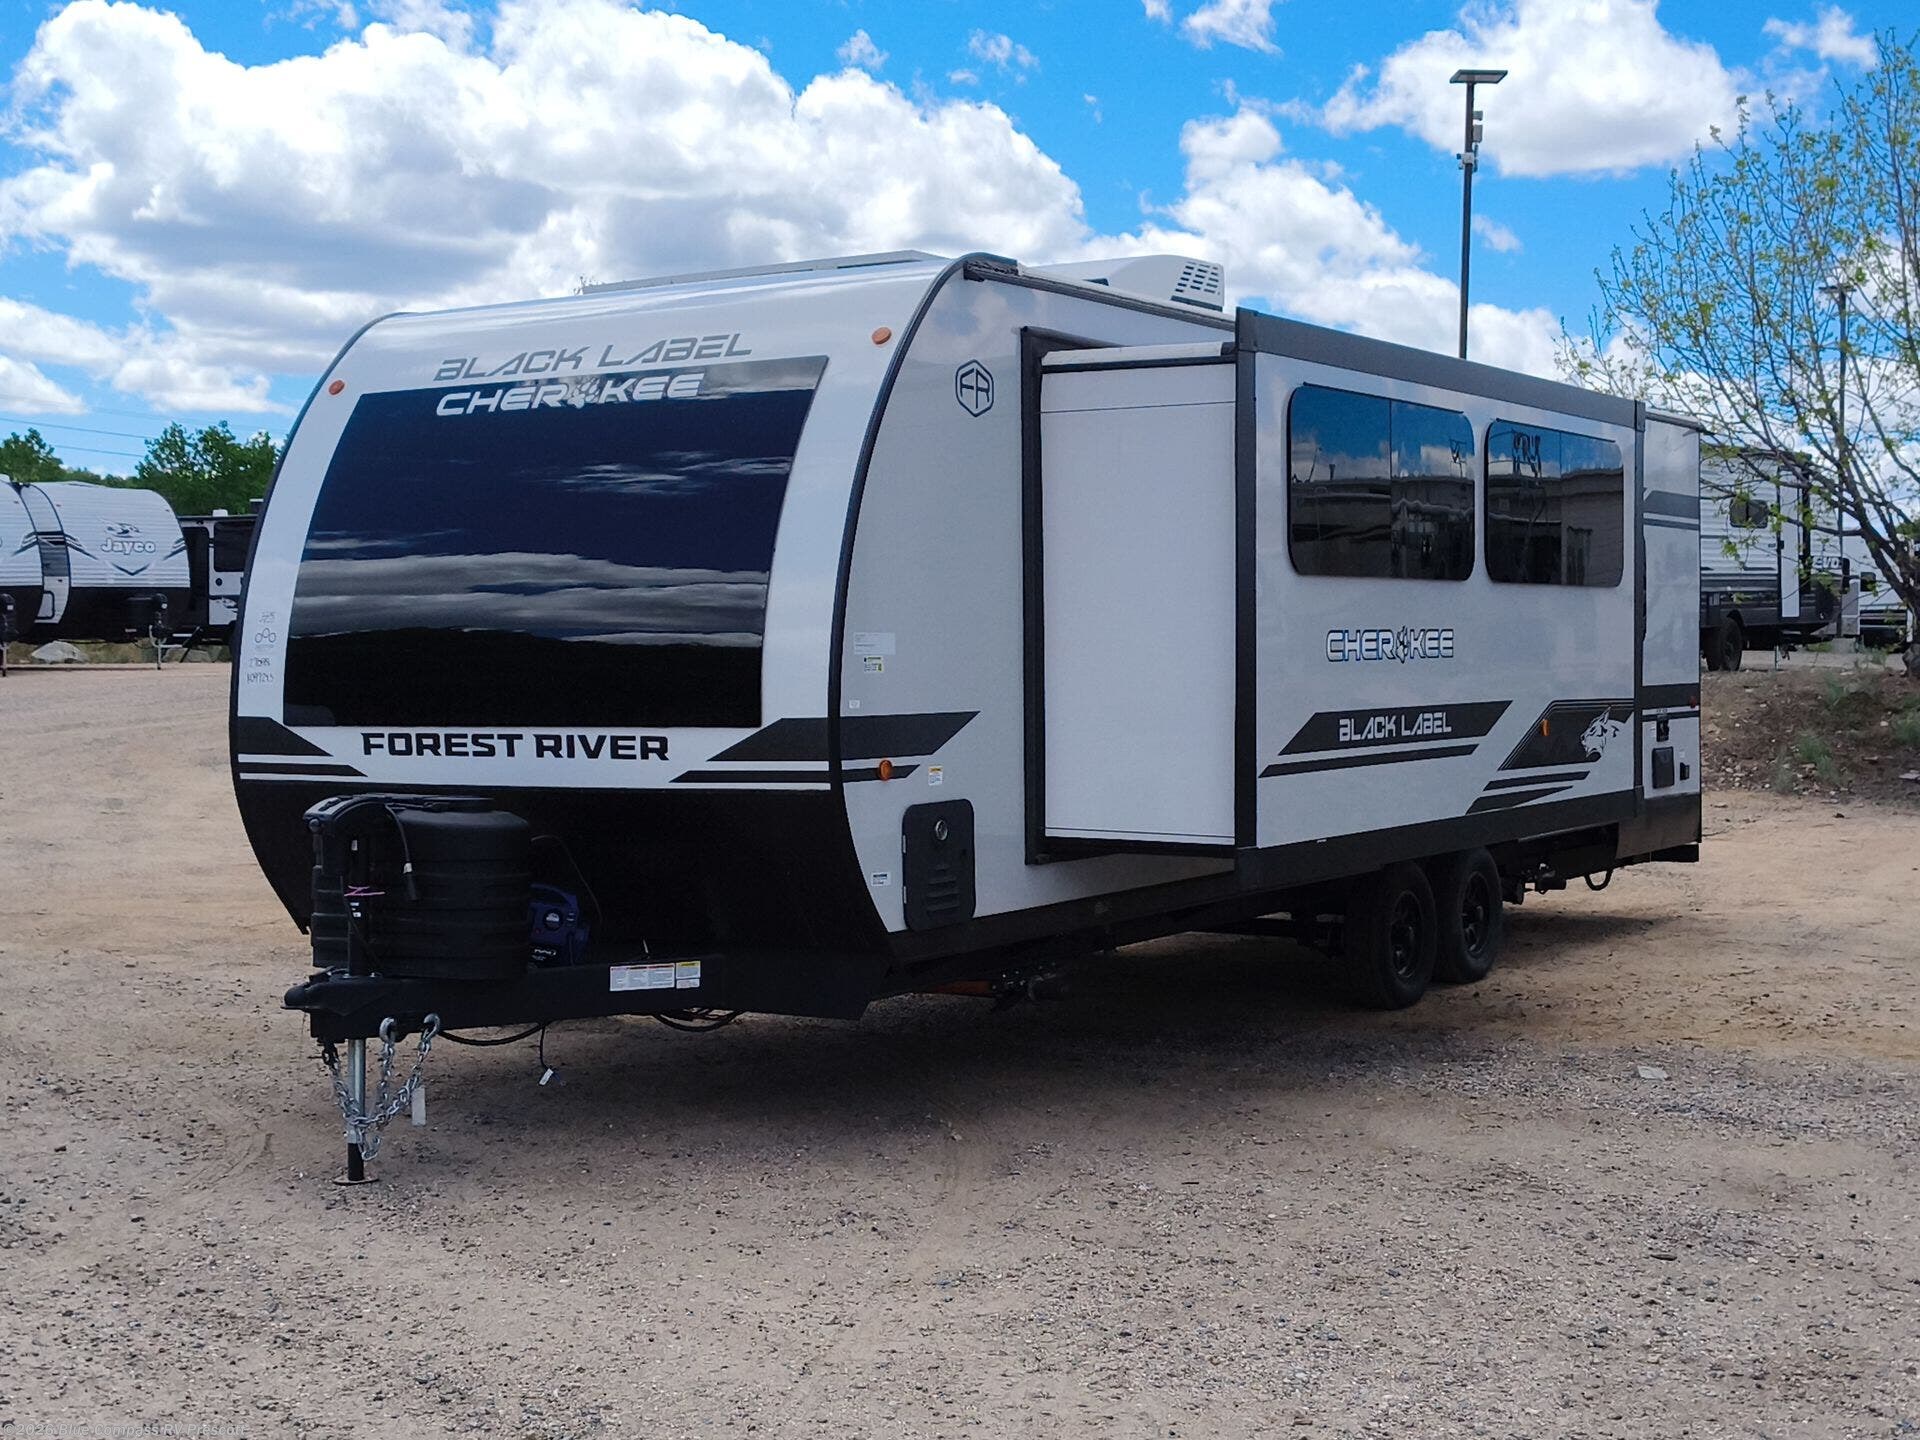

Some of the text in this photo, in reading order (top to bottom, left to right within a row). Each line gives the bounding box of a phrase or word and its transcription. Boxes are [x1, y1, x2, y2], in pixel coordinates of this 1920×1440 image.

[435, 333, 753, 381] BLACK LABEL
[100, 537, 156, 555] Jayco
[1338, 711, 1452, 742] BLACK LABEL
[360, 732, 670, 761] FOREST RIVER
